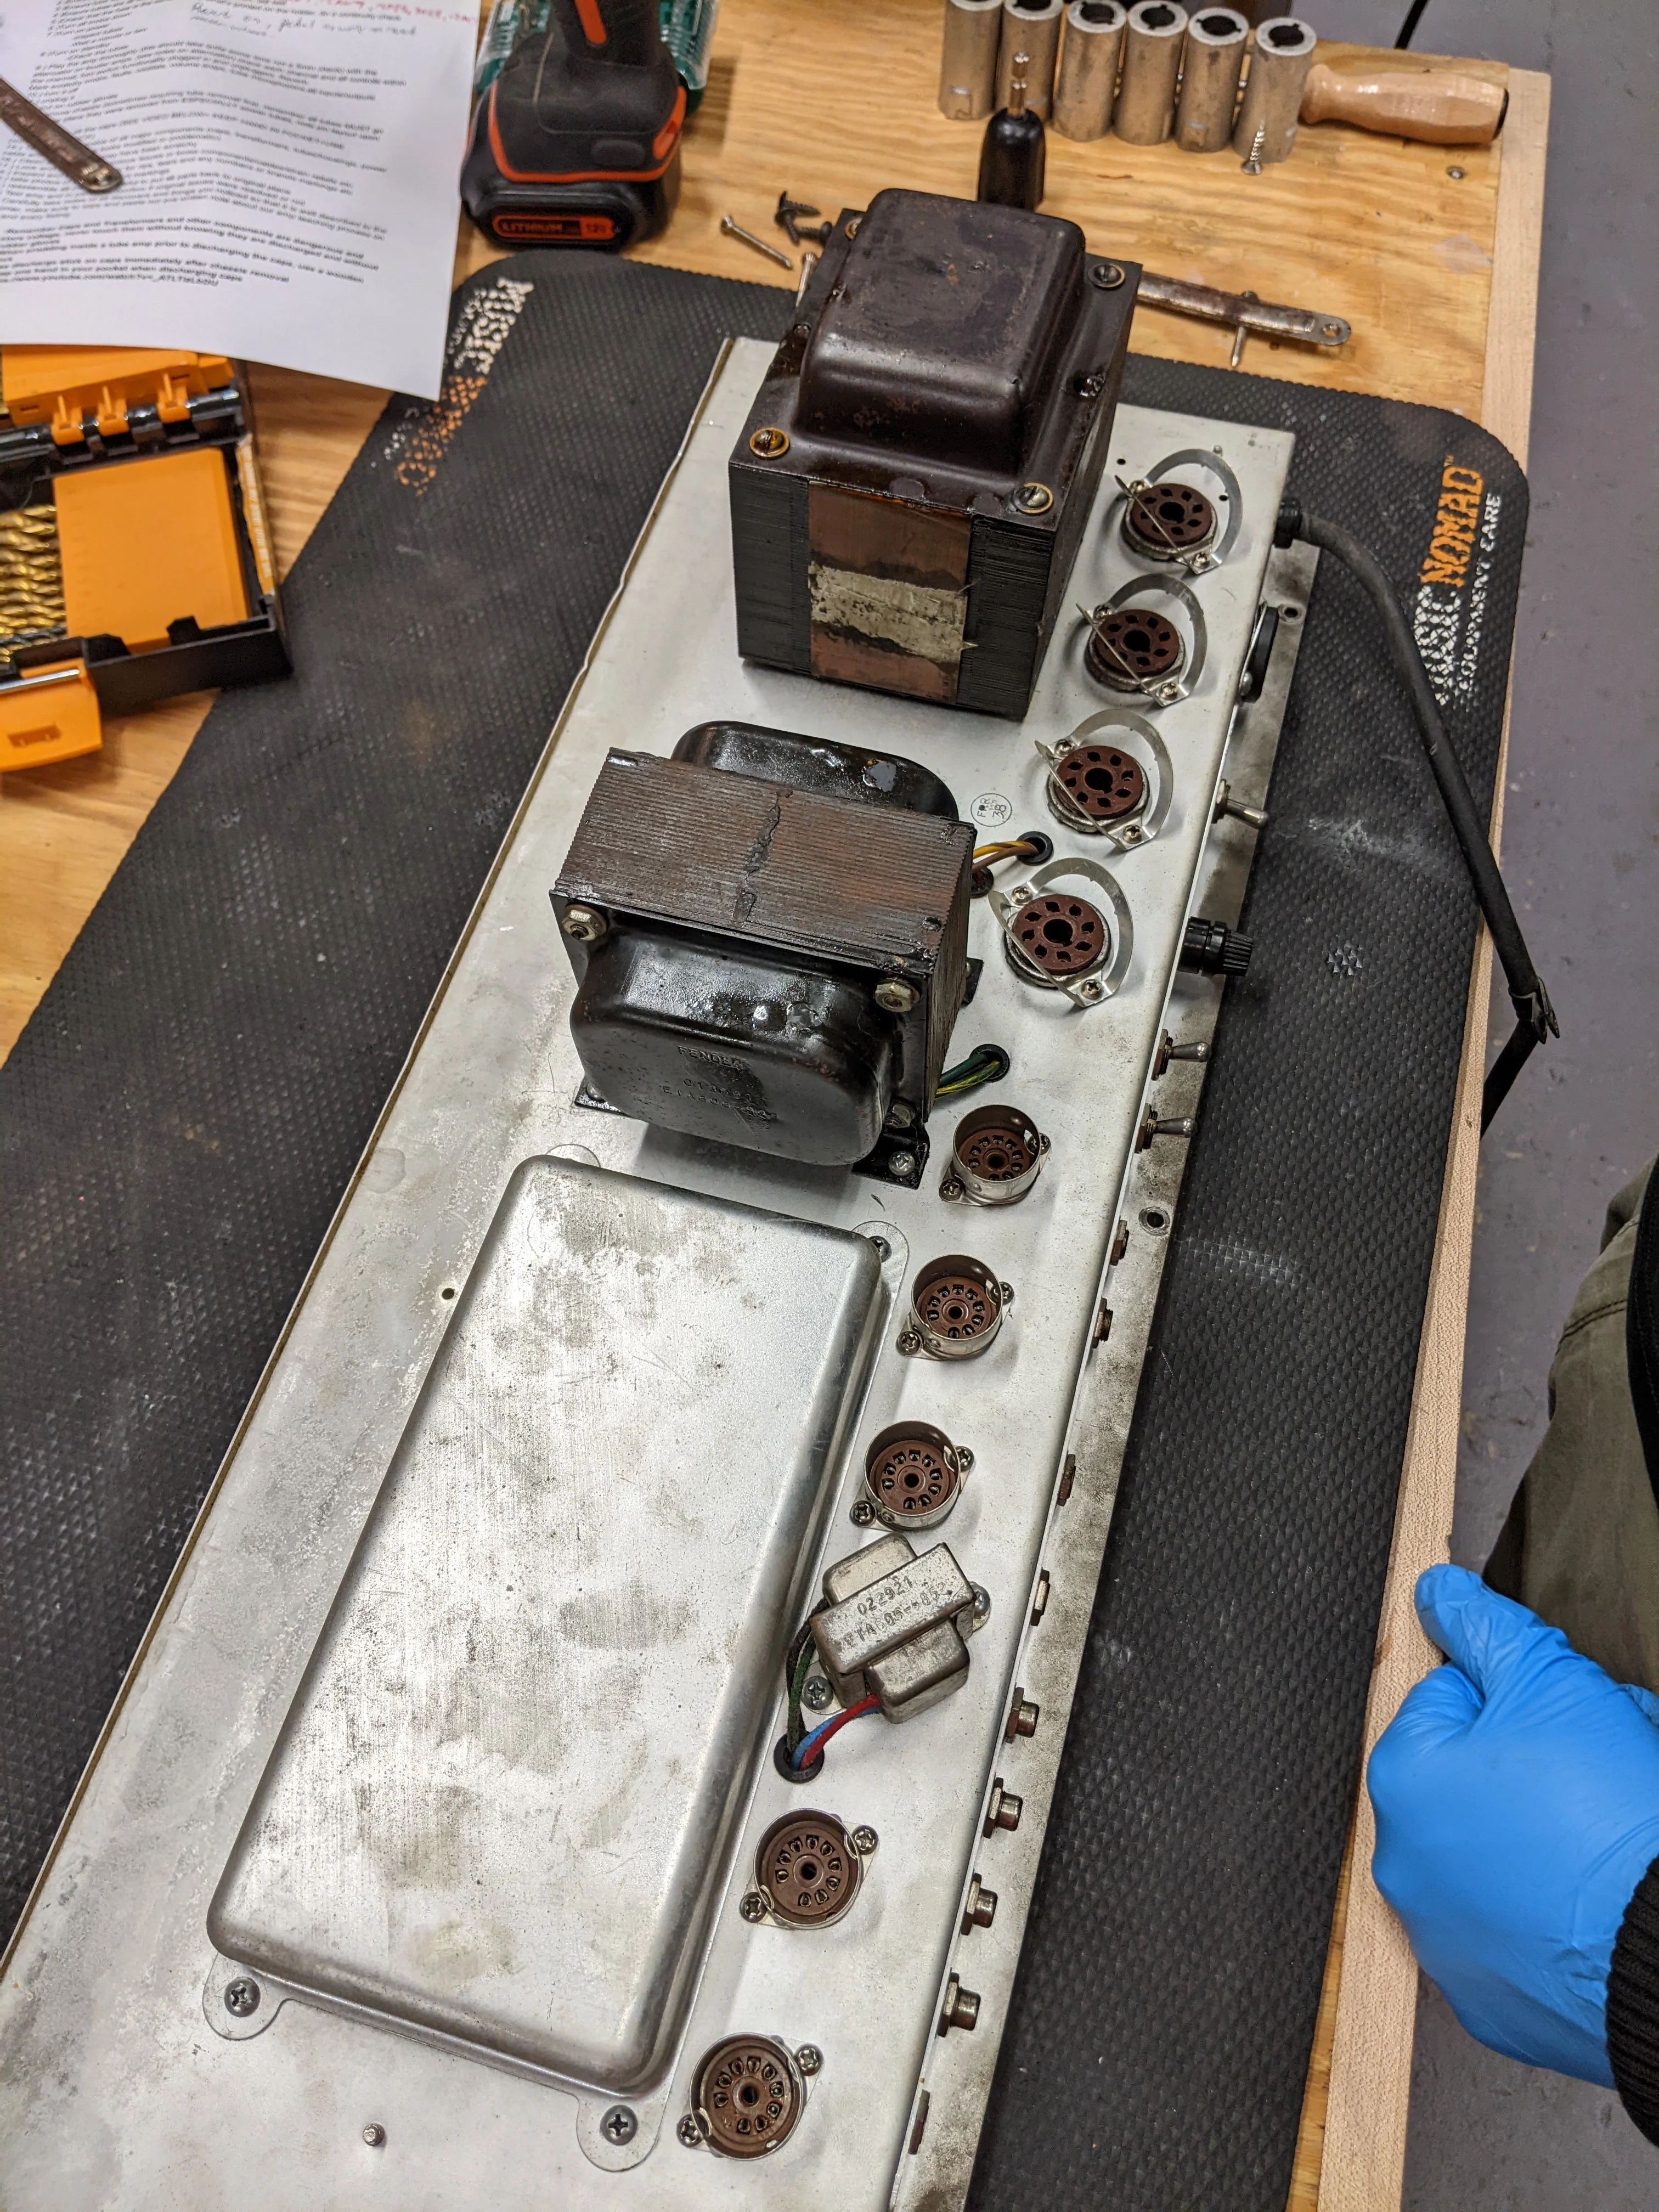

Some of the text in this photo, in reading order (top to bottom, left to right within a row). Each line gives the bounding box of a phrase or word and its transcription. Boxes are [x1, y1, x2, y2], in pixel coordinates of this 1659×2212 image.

[500, 220, 563, 233] LITHIUM
[1418, 466, 1483, 588] NOMAD
[677, 1045, 745, 1070] FENDER
[857, 1575, 913, 1616] 022921
